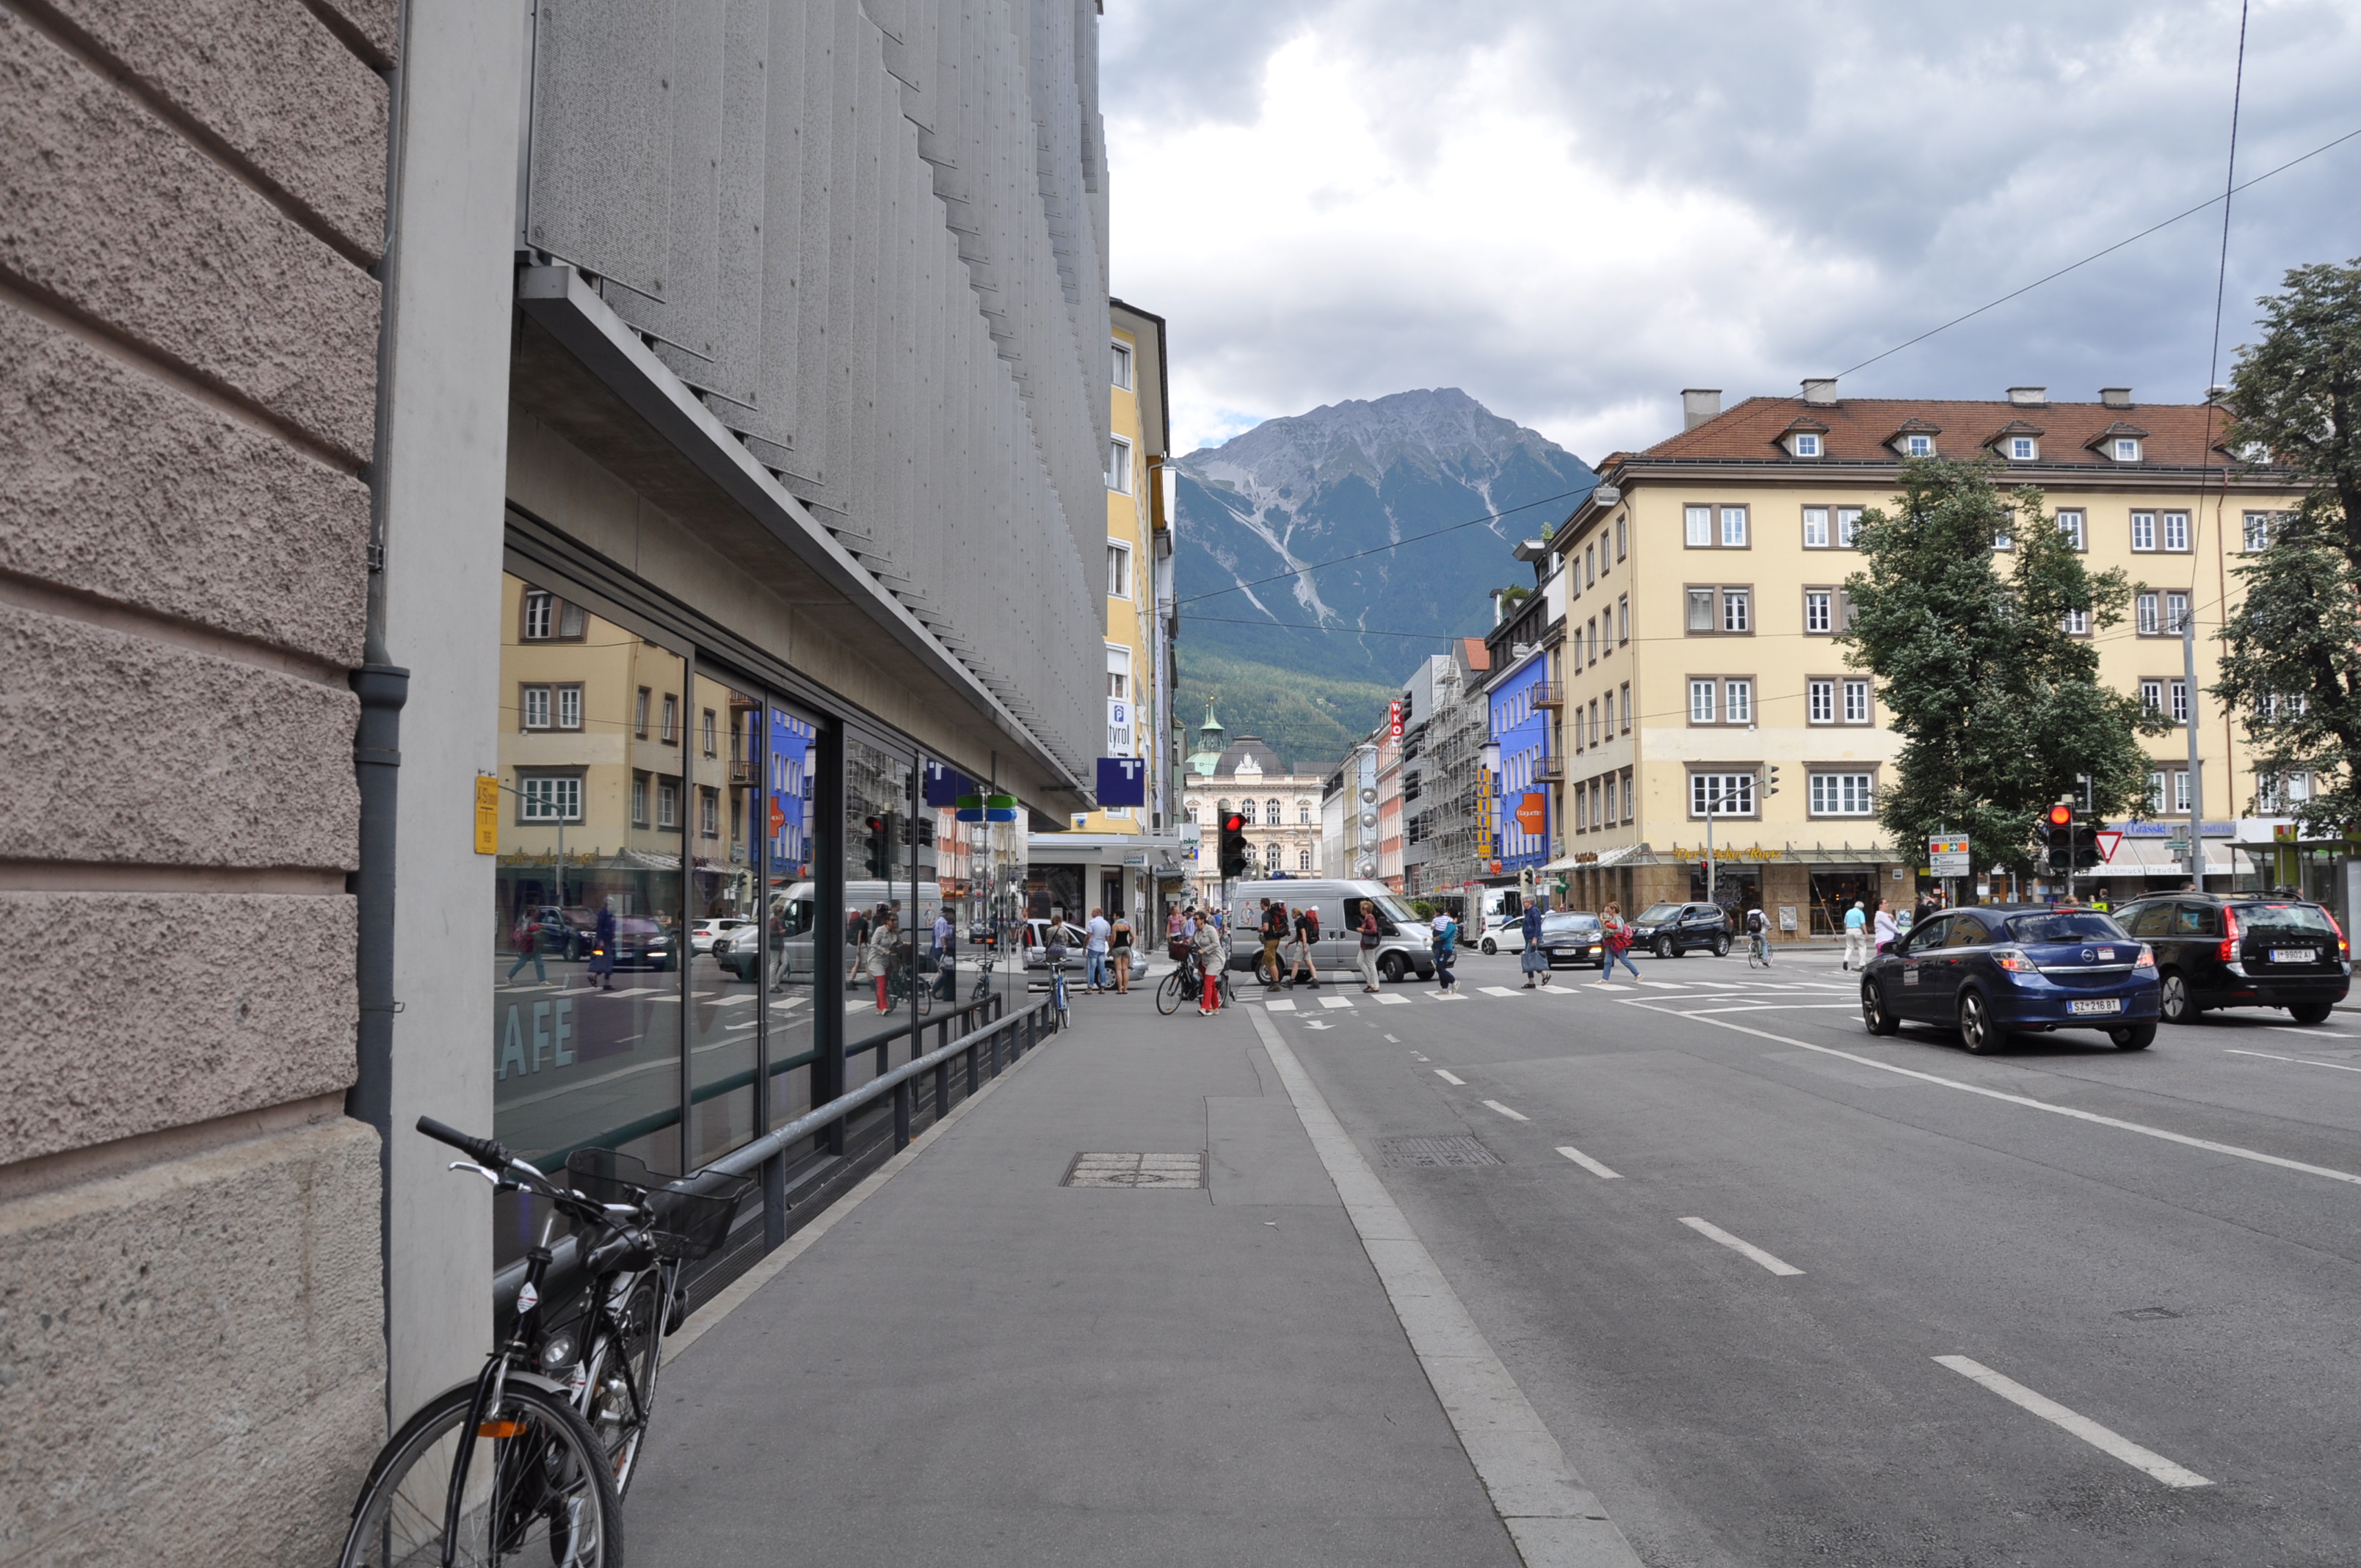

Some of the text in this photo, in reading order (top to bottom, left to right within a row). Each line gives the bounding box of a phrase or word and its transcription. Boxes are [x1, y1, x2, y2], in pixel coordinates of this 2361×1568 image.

[1392, 703, 1401, 734] WKO
[1109, 724, 1130, 748] tyrol
[1479, 770, 1490, 843] HOTEL
[1516, 810, 1542, 818] Baguette
[2201, 825, 2233, 833] UWELEN
[1672, 847, 1700, 860] Der
[1745, 847, 1782, 860] Ruetz
[2285, 951, 2302, 959] 9902
[2074, 1000, 2116, 1011] SZ 216 BT
